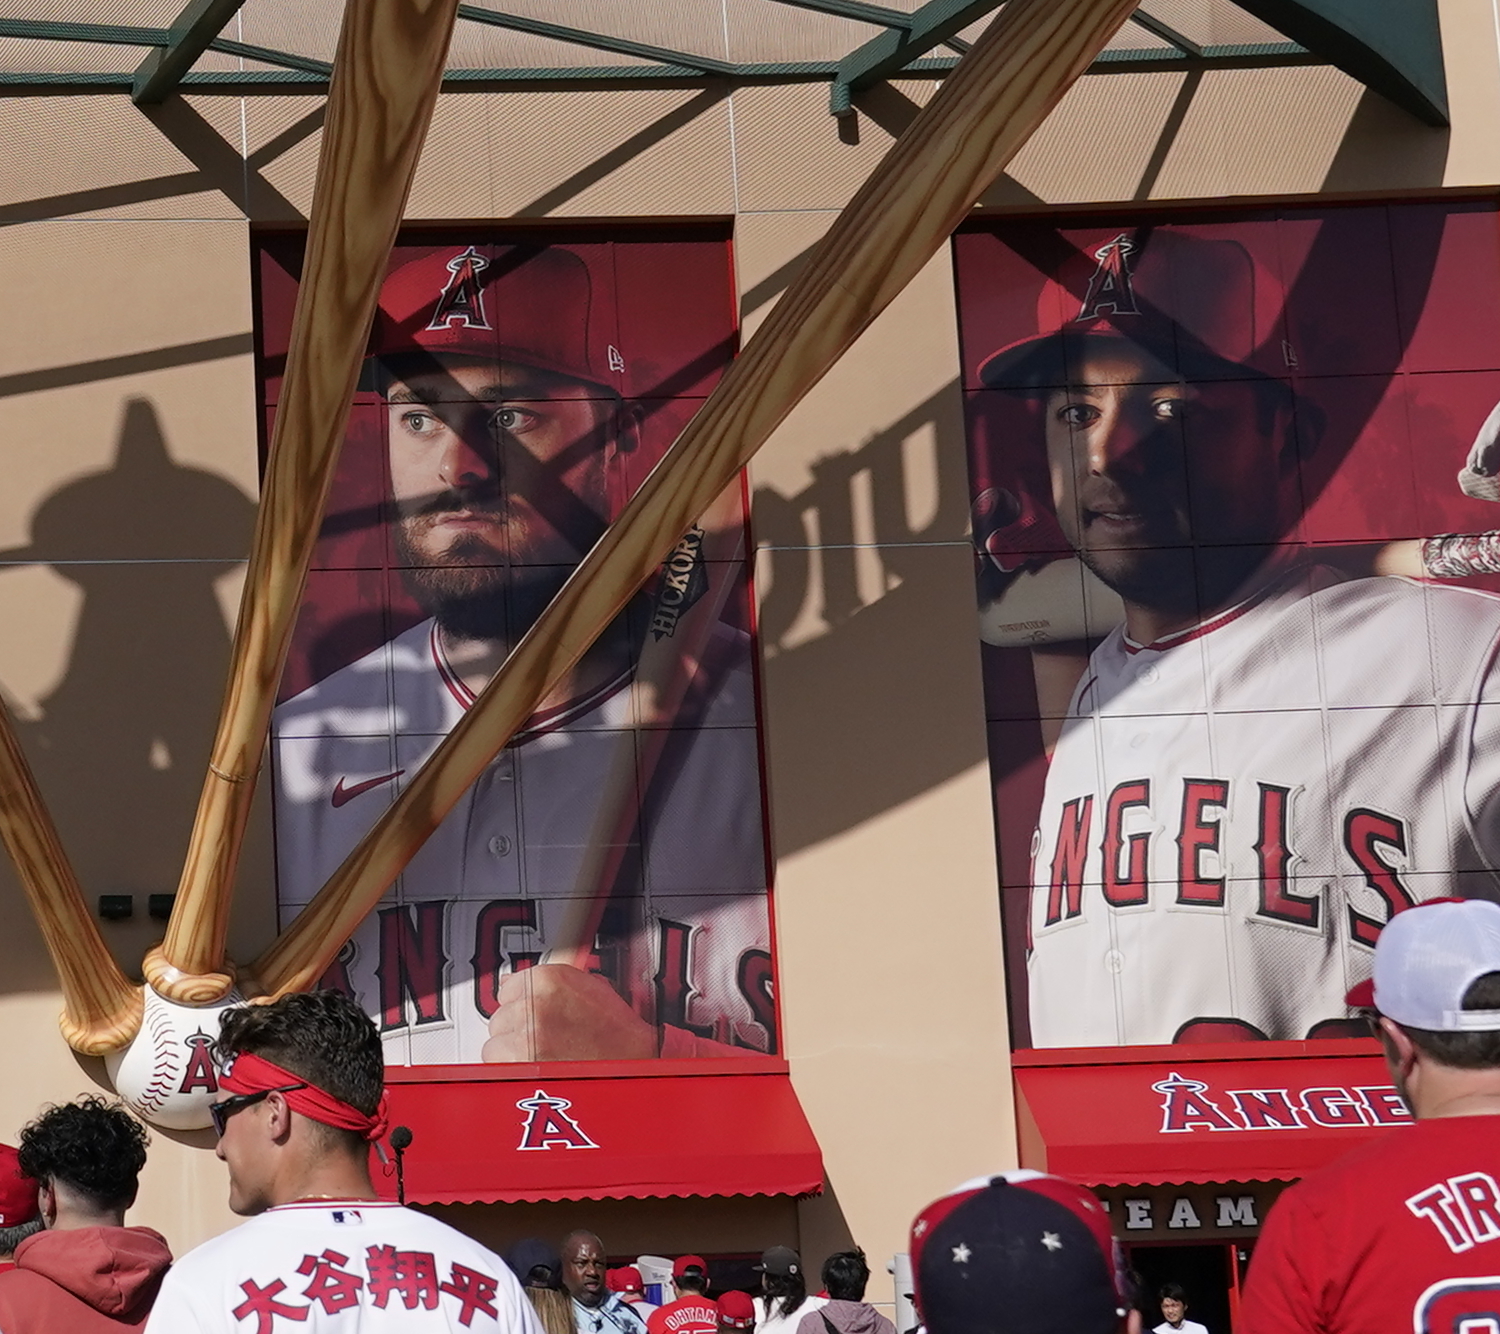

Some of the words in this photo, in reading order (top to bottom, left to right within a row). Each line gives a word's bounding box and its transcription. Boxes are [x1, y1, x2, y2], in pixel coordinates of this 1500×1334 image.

[425, 245, 493, 332] A
[1028, 778, 1419, 952] NGELS
[177, 1023, 219, 1095] A
[514, 1088, 600, 1152] A
[1151, 1072, 1416, 1133] ANGE
[1103, 1196, 1259, 1231] EAM
[665, 1307, 718, 1331] OHTAN
